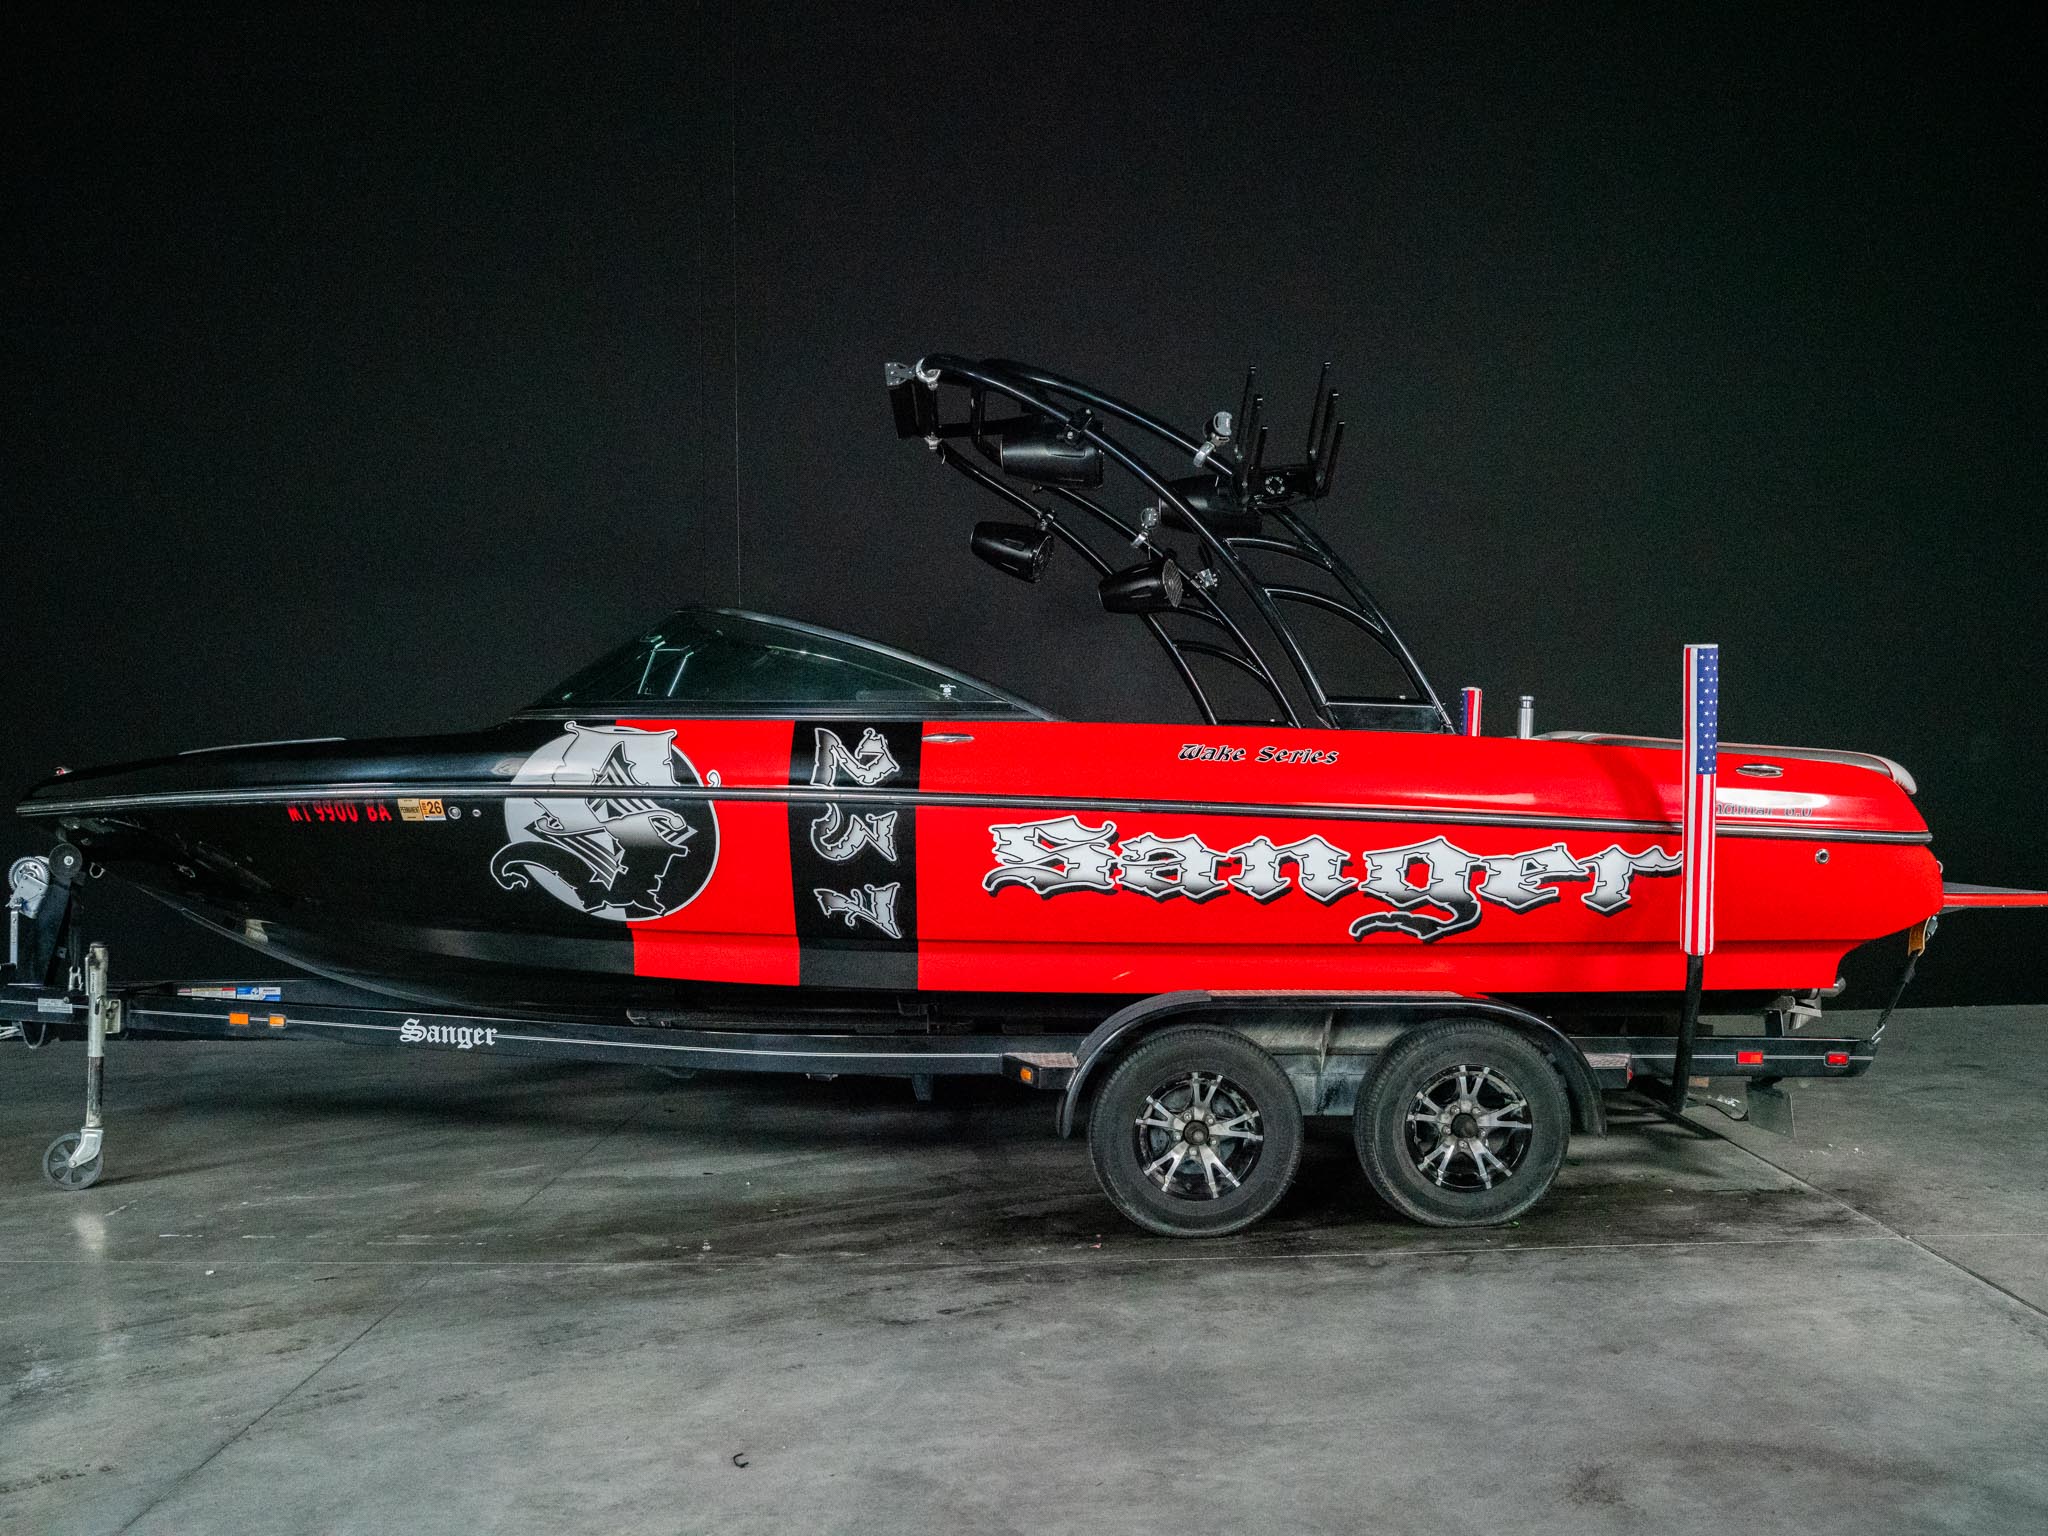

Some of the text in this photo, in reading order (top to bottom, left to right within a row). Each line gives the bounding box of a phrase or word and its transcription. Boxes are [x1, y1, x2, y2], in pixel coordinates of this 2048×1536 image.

[1178, 744, 1340, 764] Wake Series
[313, 800, 359, 823] 9900
[426, 800, 442, 815] 26
[983, 816, 1682, 942] Sanger
[400, 1018, 498, 1049] Sanger
